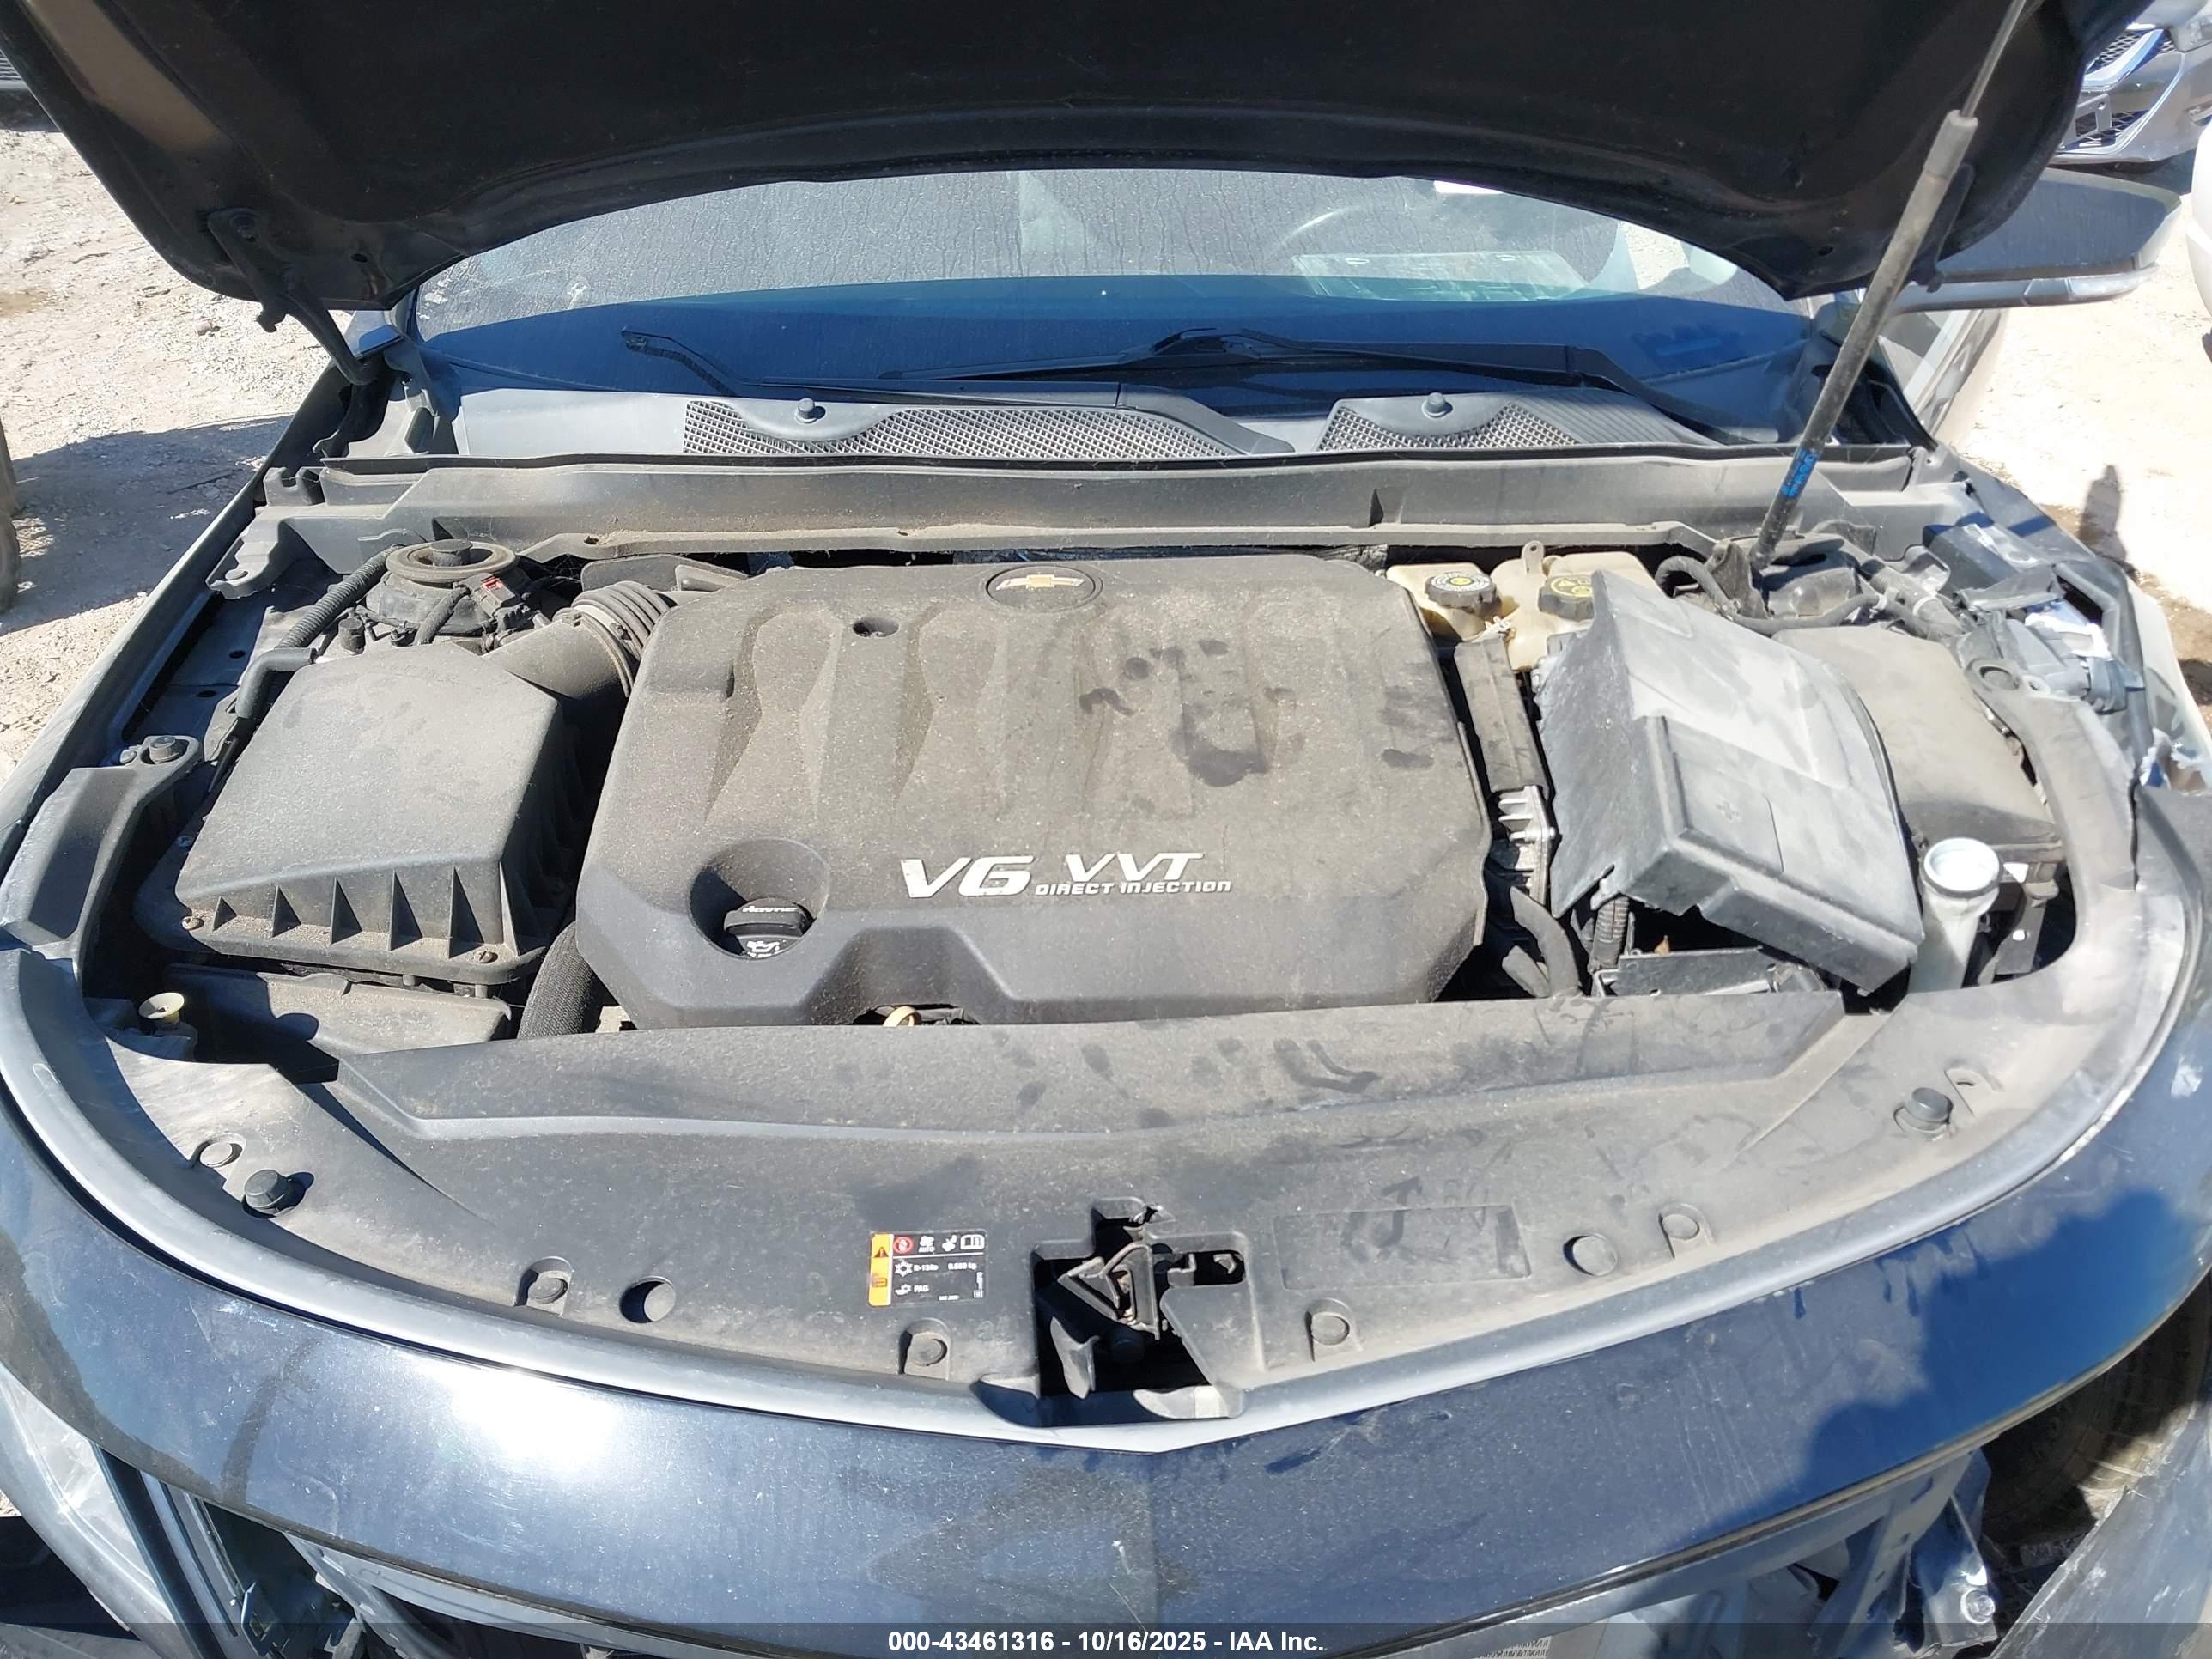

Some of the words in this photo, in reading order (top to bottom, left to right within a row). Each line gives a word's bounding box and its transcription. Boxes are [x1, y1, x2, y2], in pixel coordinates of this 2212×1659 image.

[900, 855, 1034, 899] V6
[1066, 852, 1204, 883] VVT
[1035, 882, 1115, 896] DIRECT
[1120, 880, 1232, 894] INJECTION
